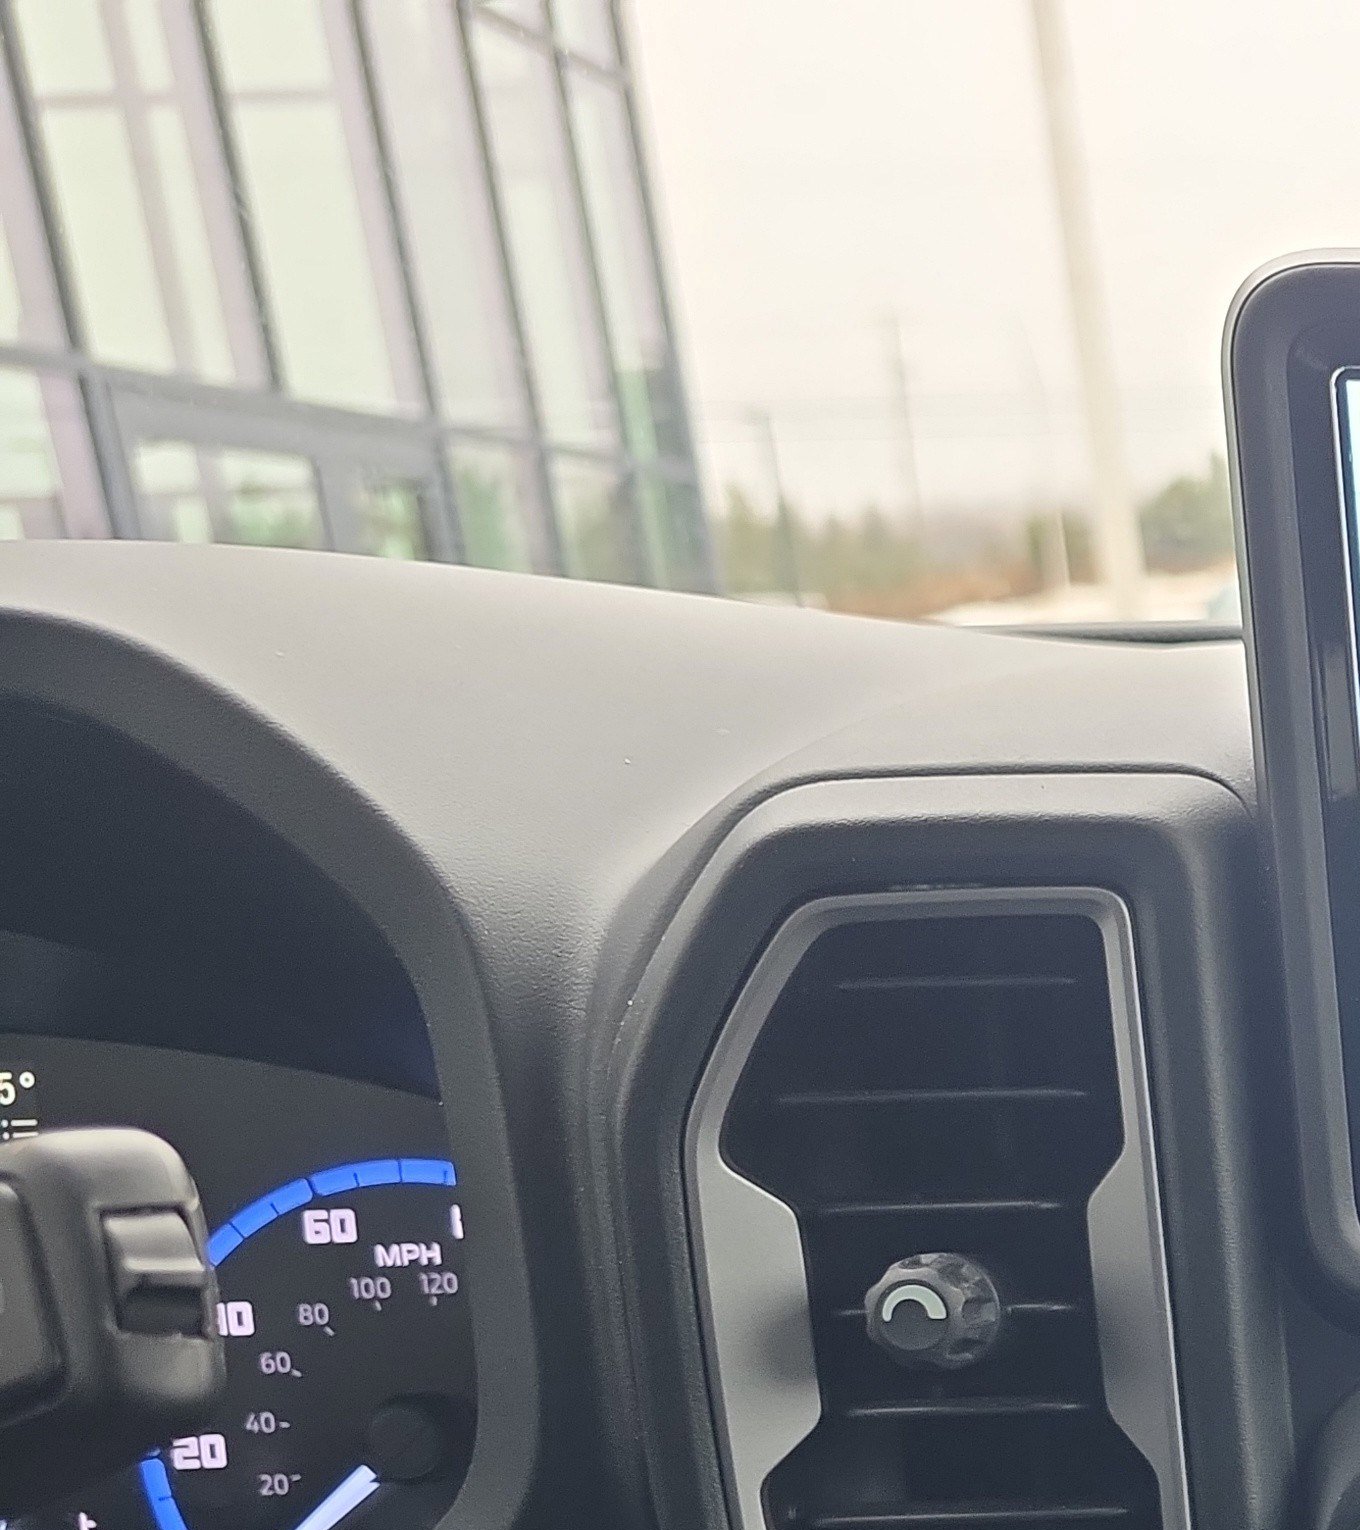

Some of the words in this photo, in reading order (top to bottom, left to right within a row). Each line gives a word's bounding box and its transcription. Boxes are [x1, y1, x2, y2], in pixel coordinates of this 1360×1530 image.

[303, 1208, 358, 1244] 60
[374, 1242, 442, 1267] MPH
[350, 1276, 392, 1299] 100
[419, 1272, 459, 1294] 120
[299, 1303, 330, 1326] 80
[260, 1351, 291, 1375] 60
[246, 1411, 276, 1434] 40
[172, 1433, 228, 1470] 20
[259, 1473, 290, 1496] 20
